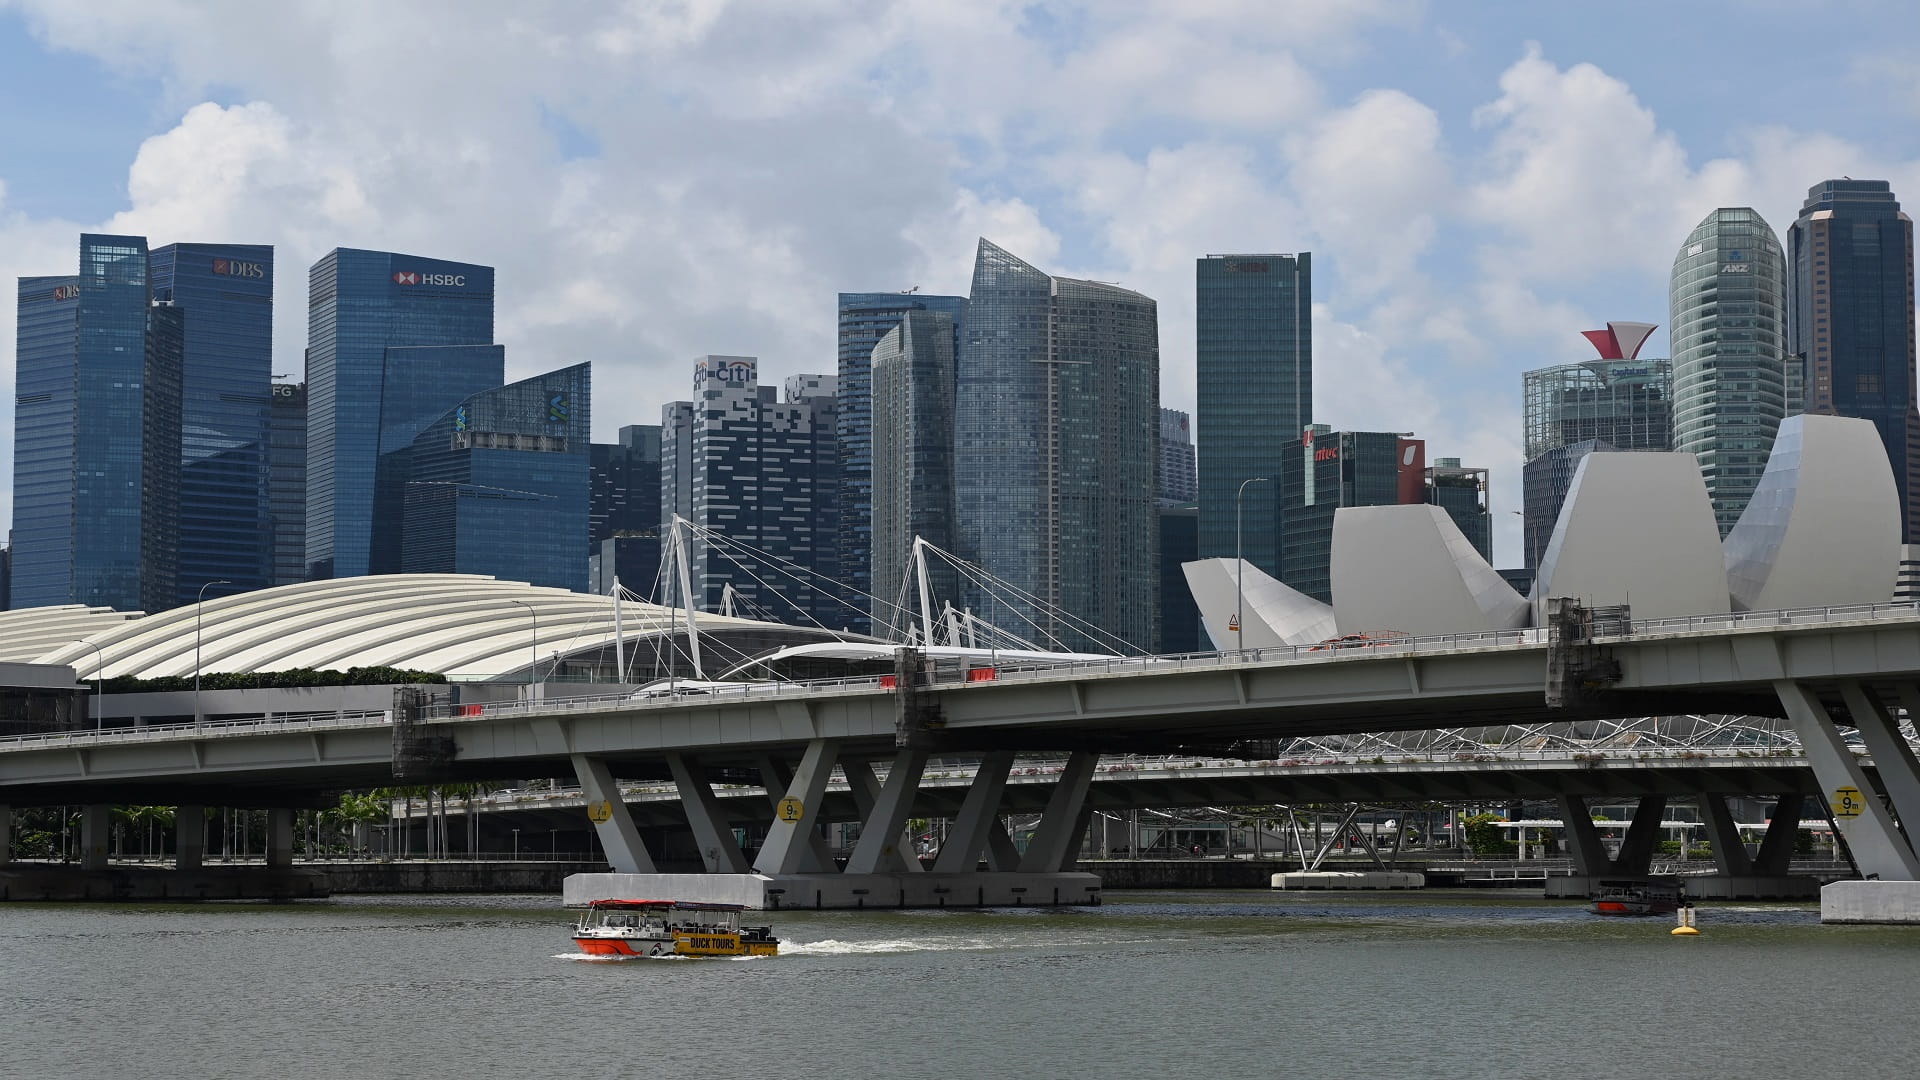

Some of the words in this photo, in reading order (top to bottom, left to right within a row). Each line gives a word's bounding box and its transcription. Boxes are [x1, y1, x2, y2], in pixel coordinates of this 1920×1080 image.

[230, 260, 264, 278] DBS
[1721, 264, 1750, 273] ANZ
[422, 273, 465, 287] HSBC
[715, 364, 750, 383] citi
[690, 937, 711, 949] DUCK
[712, 938, 735, 950] TOURS
